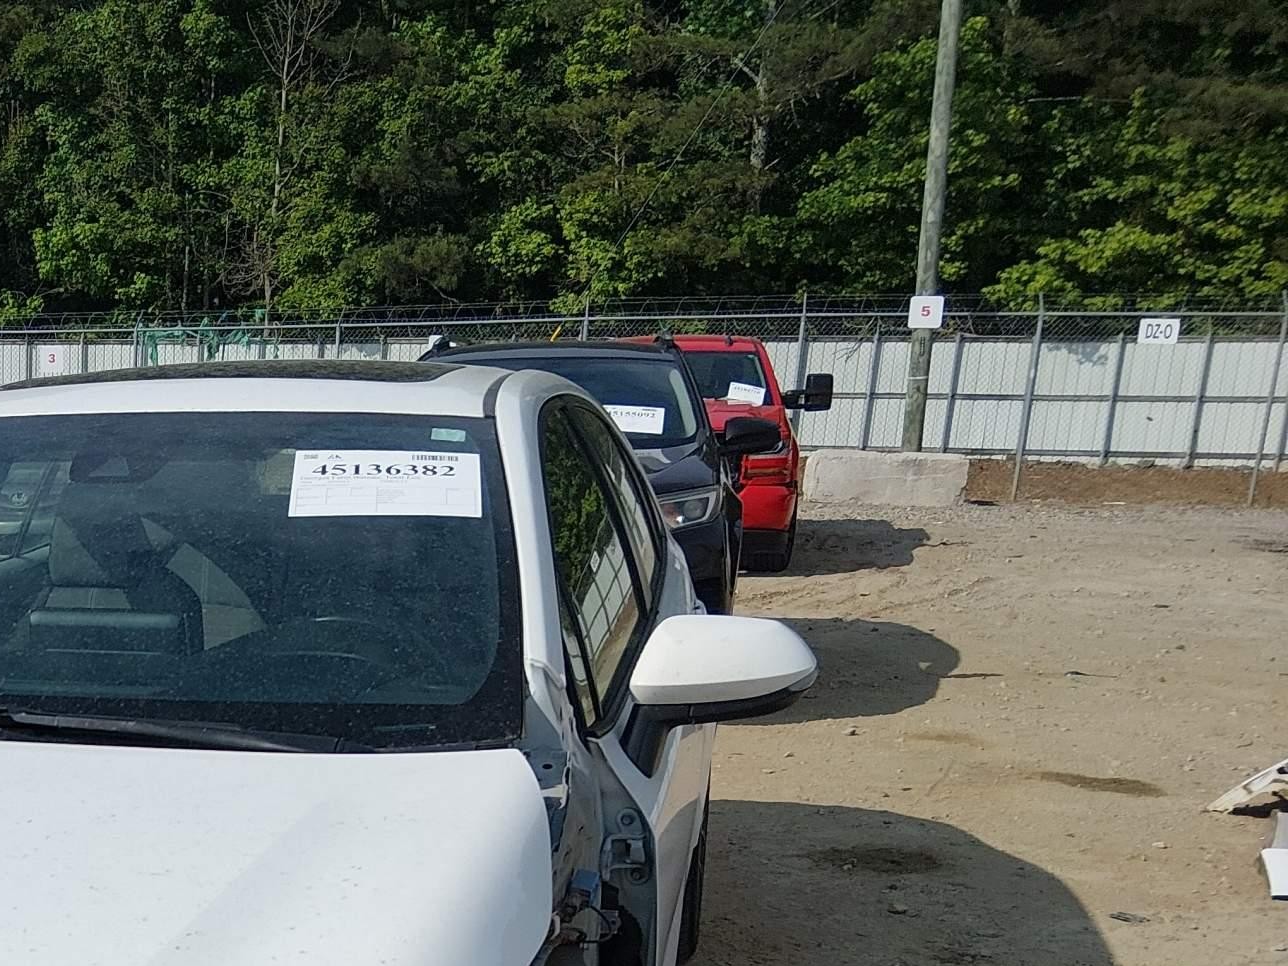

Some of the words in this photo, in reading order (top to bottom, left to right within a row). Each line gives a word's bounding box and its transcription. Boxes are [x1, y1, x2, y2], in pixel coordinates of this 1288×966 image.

[921, 305, 931, 317] 5
[48, 353, 56, 363] 3
[312, 463, 456, 477] 45136382
